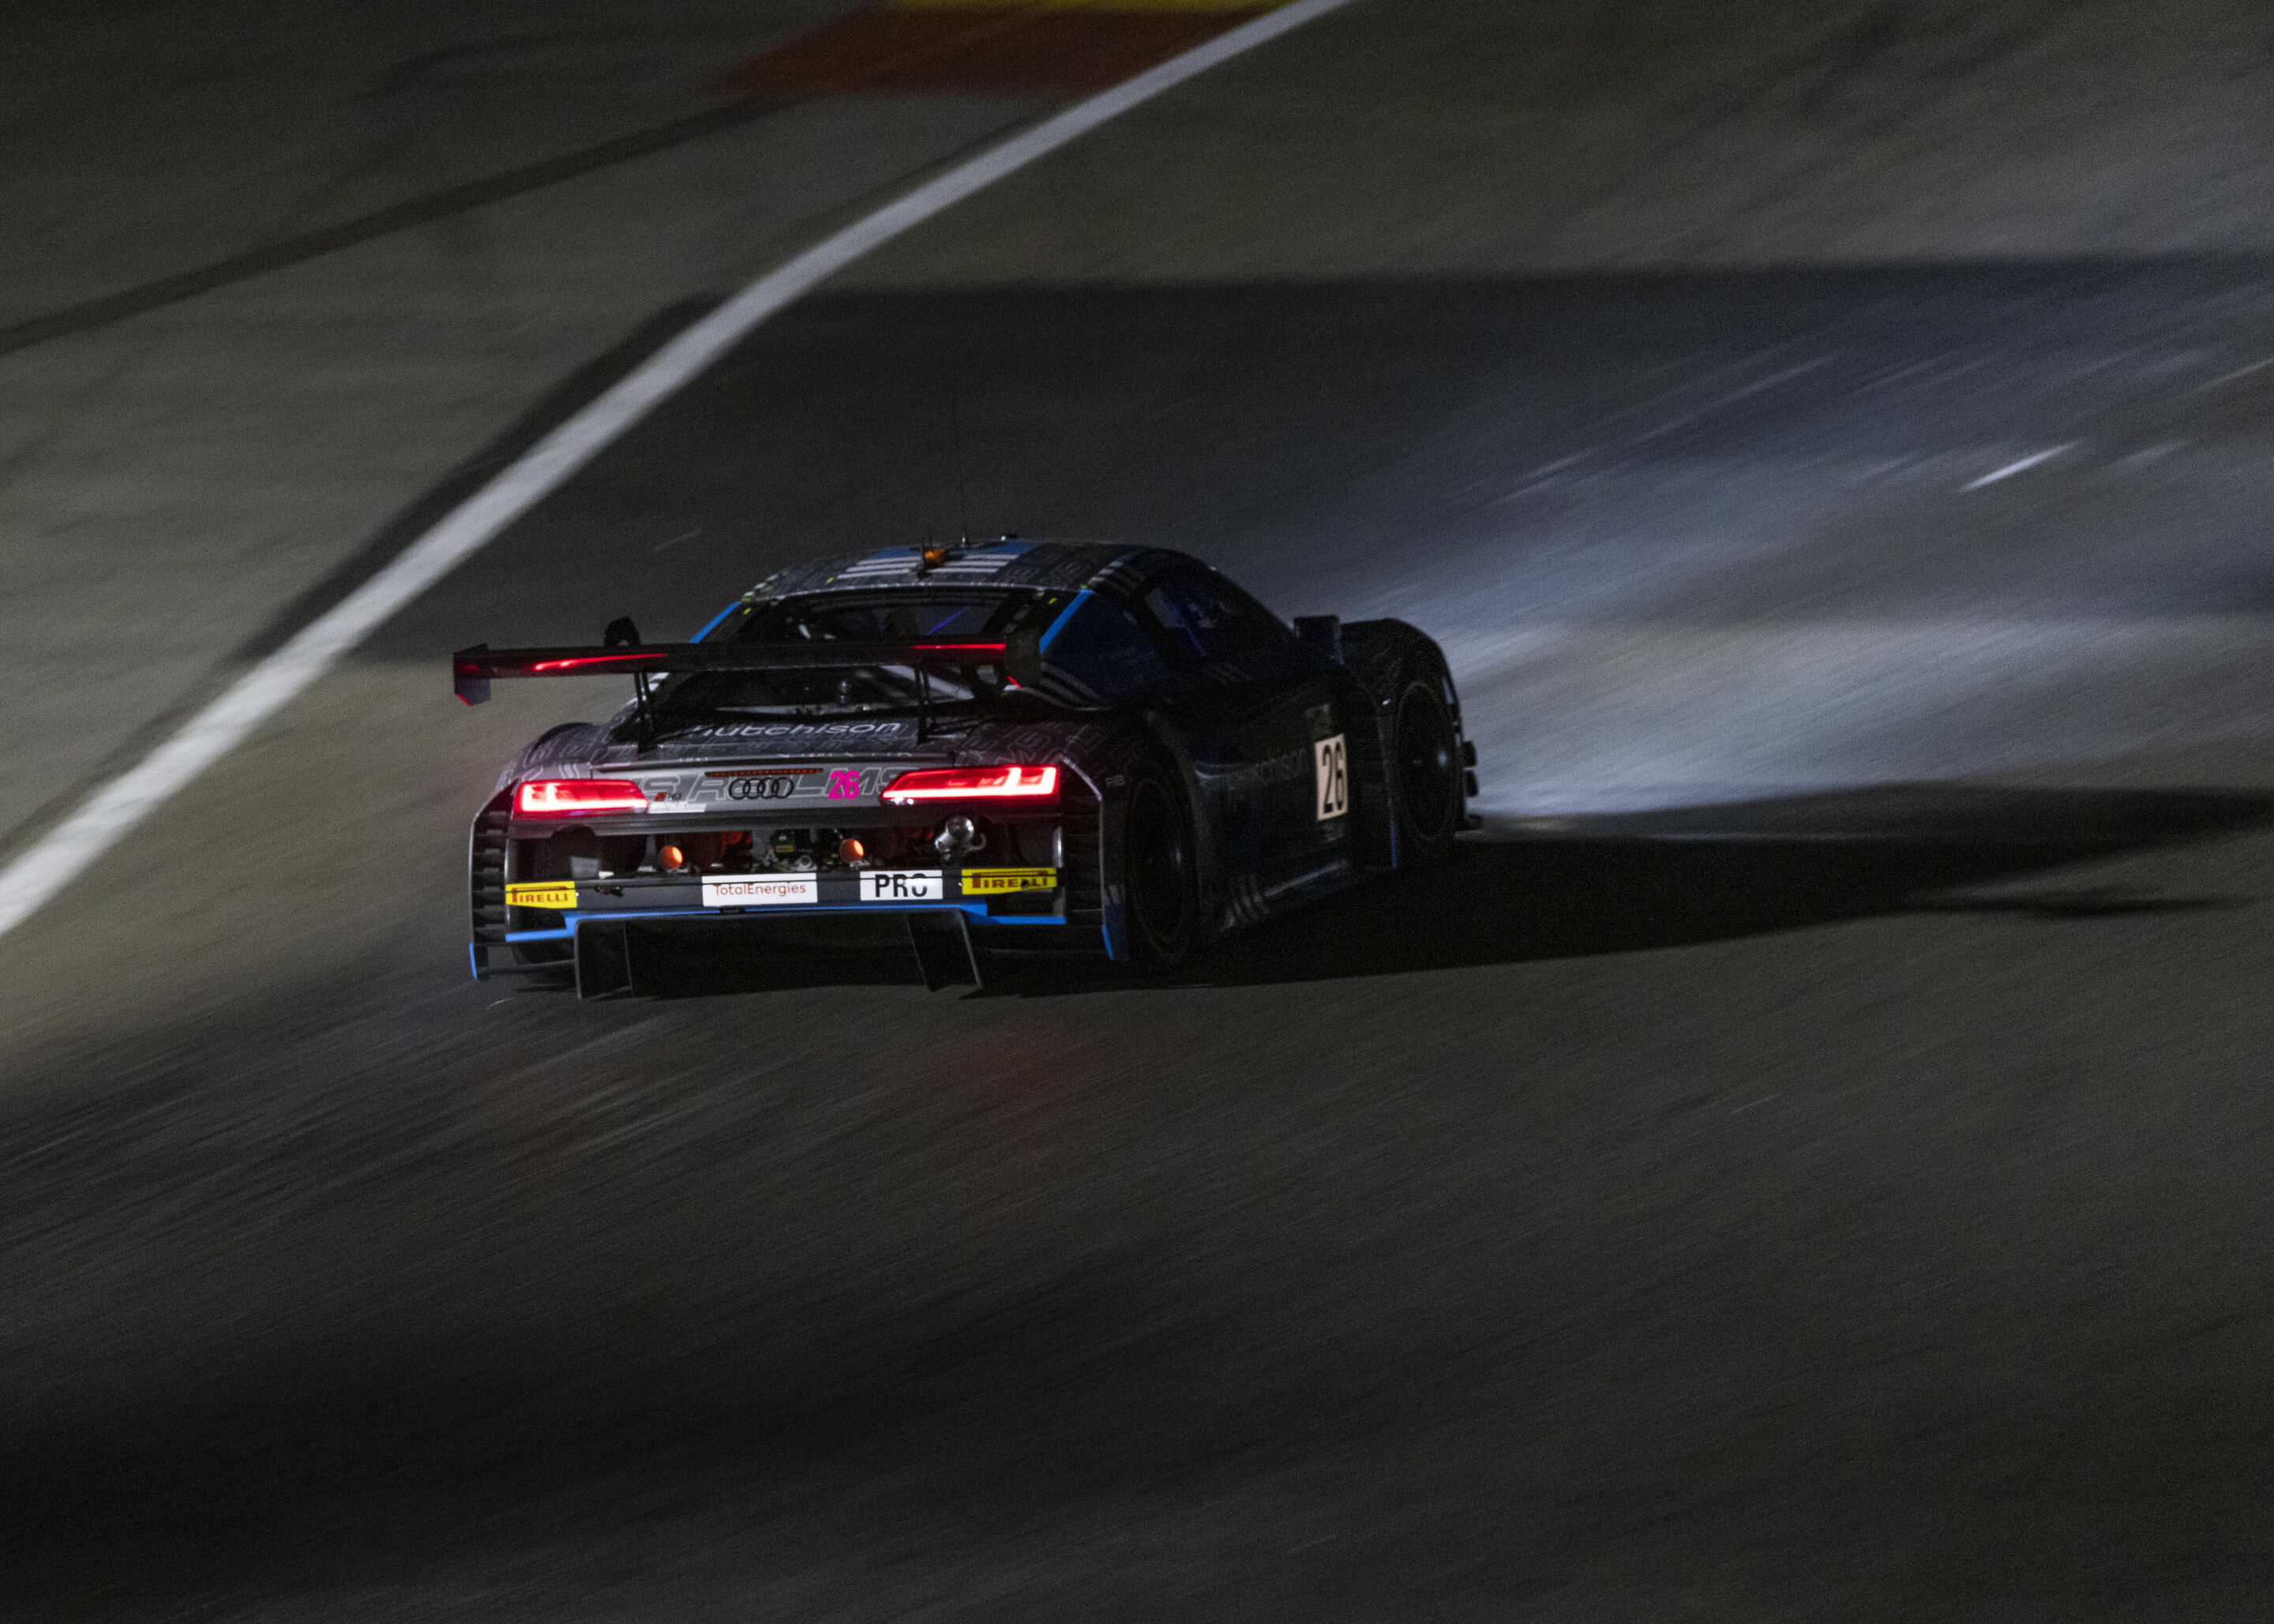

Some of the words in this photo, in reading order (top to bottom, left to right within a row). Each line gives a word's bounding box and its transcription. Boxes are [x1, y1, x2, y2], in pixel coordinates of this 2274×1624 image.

[828, 770, 859, 799] 26
[1323, 743, 1343, 813] 26
[713, 882, 806, 897] TotalEnergies
[875, 873, 927, 897] PRO
[972, 870, 1048, 888] PIRELI
[512, 886, 568, 902] PIRELLI
